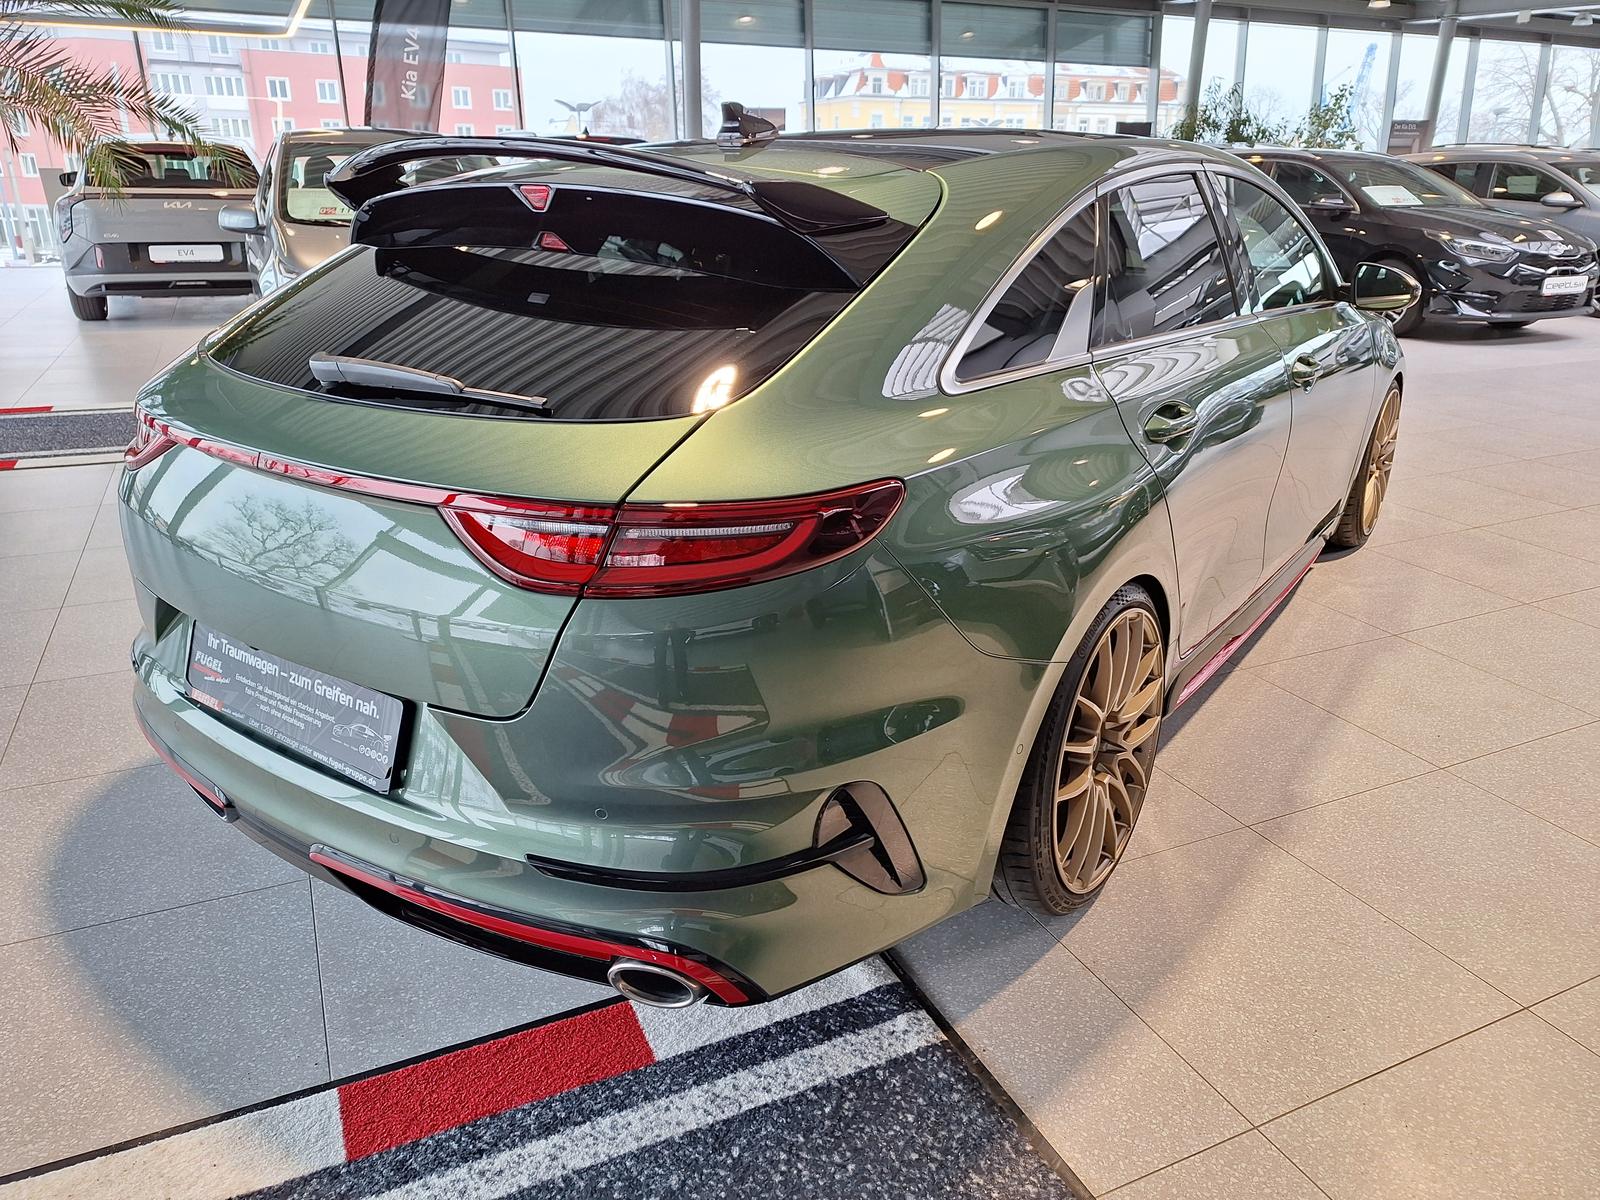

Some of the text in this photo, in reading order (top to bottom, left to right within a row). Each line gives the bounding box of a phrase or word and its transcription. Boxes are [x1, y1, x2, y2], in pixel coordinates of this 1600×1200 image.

[400, 27, 420, 100] Kia EV4
[177, 249, 195, 257] EV4
[195, 650, 223, 673] FUGEL
[207, 632, 220, 650] Ihr
[220, 638, 279, 677] Traumwagen
[289, 671, 312, 691] zum
[314, 679, 353, 708] Greifen
[355, 698, 380, 719] nah.
[312, 750, 377, 787] www.fugel-gruppe.de
